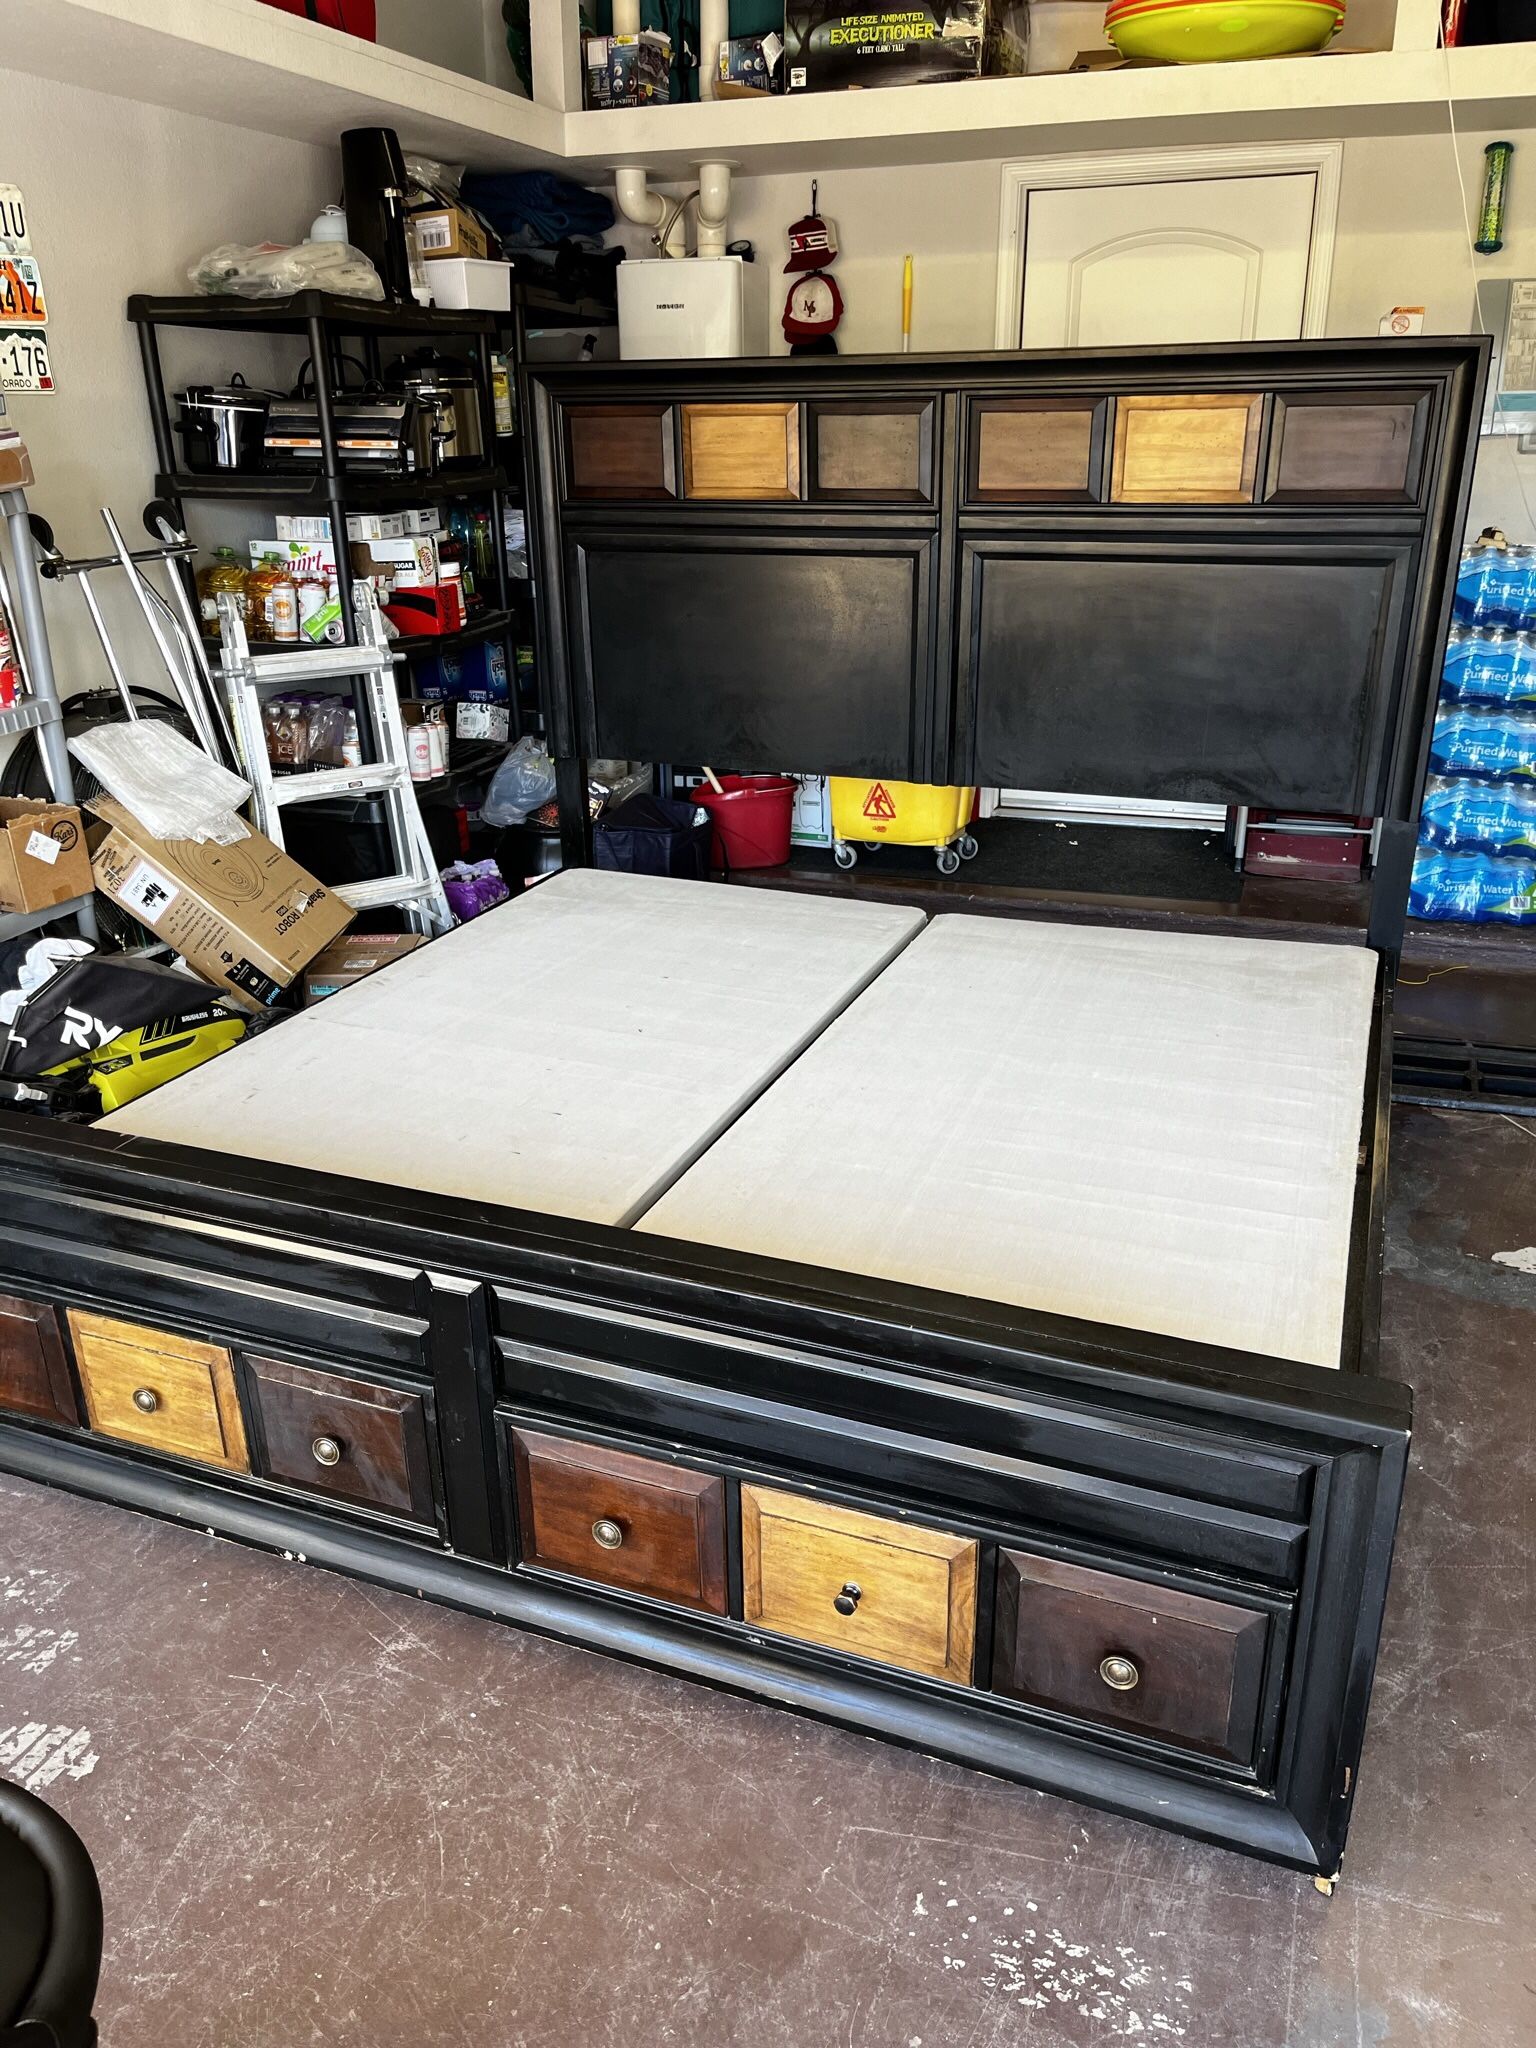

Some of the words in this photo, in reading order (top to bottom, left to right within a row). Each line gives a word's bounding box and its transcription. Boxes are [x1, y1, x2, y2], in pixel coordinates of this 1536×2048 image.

[881, 12, 924, 23] ANIMATED
[830, 22, 935, 45] EXECUTIONER
[862, 46, 874, 54] FEET
[892, 44, 905, 52] TALL
[1479, 583, 1525, 597] Puried
[1464, 668, 1509, 682] Purfied
[1455, 743, 1499, 757] Purified
[1502, 747, 1535, 760] Water
[1454, 812, 1499, 826] Purified
[1502, 816, 1535, 829] Water
[1483, 884, 1513, 895] Water
[275, 911, 300, 936] ROBOT
[265, 986, 281, 1006] prime
